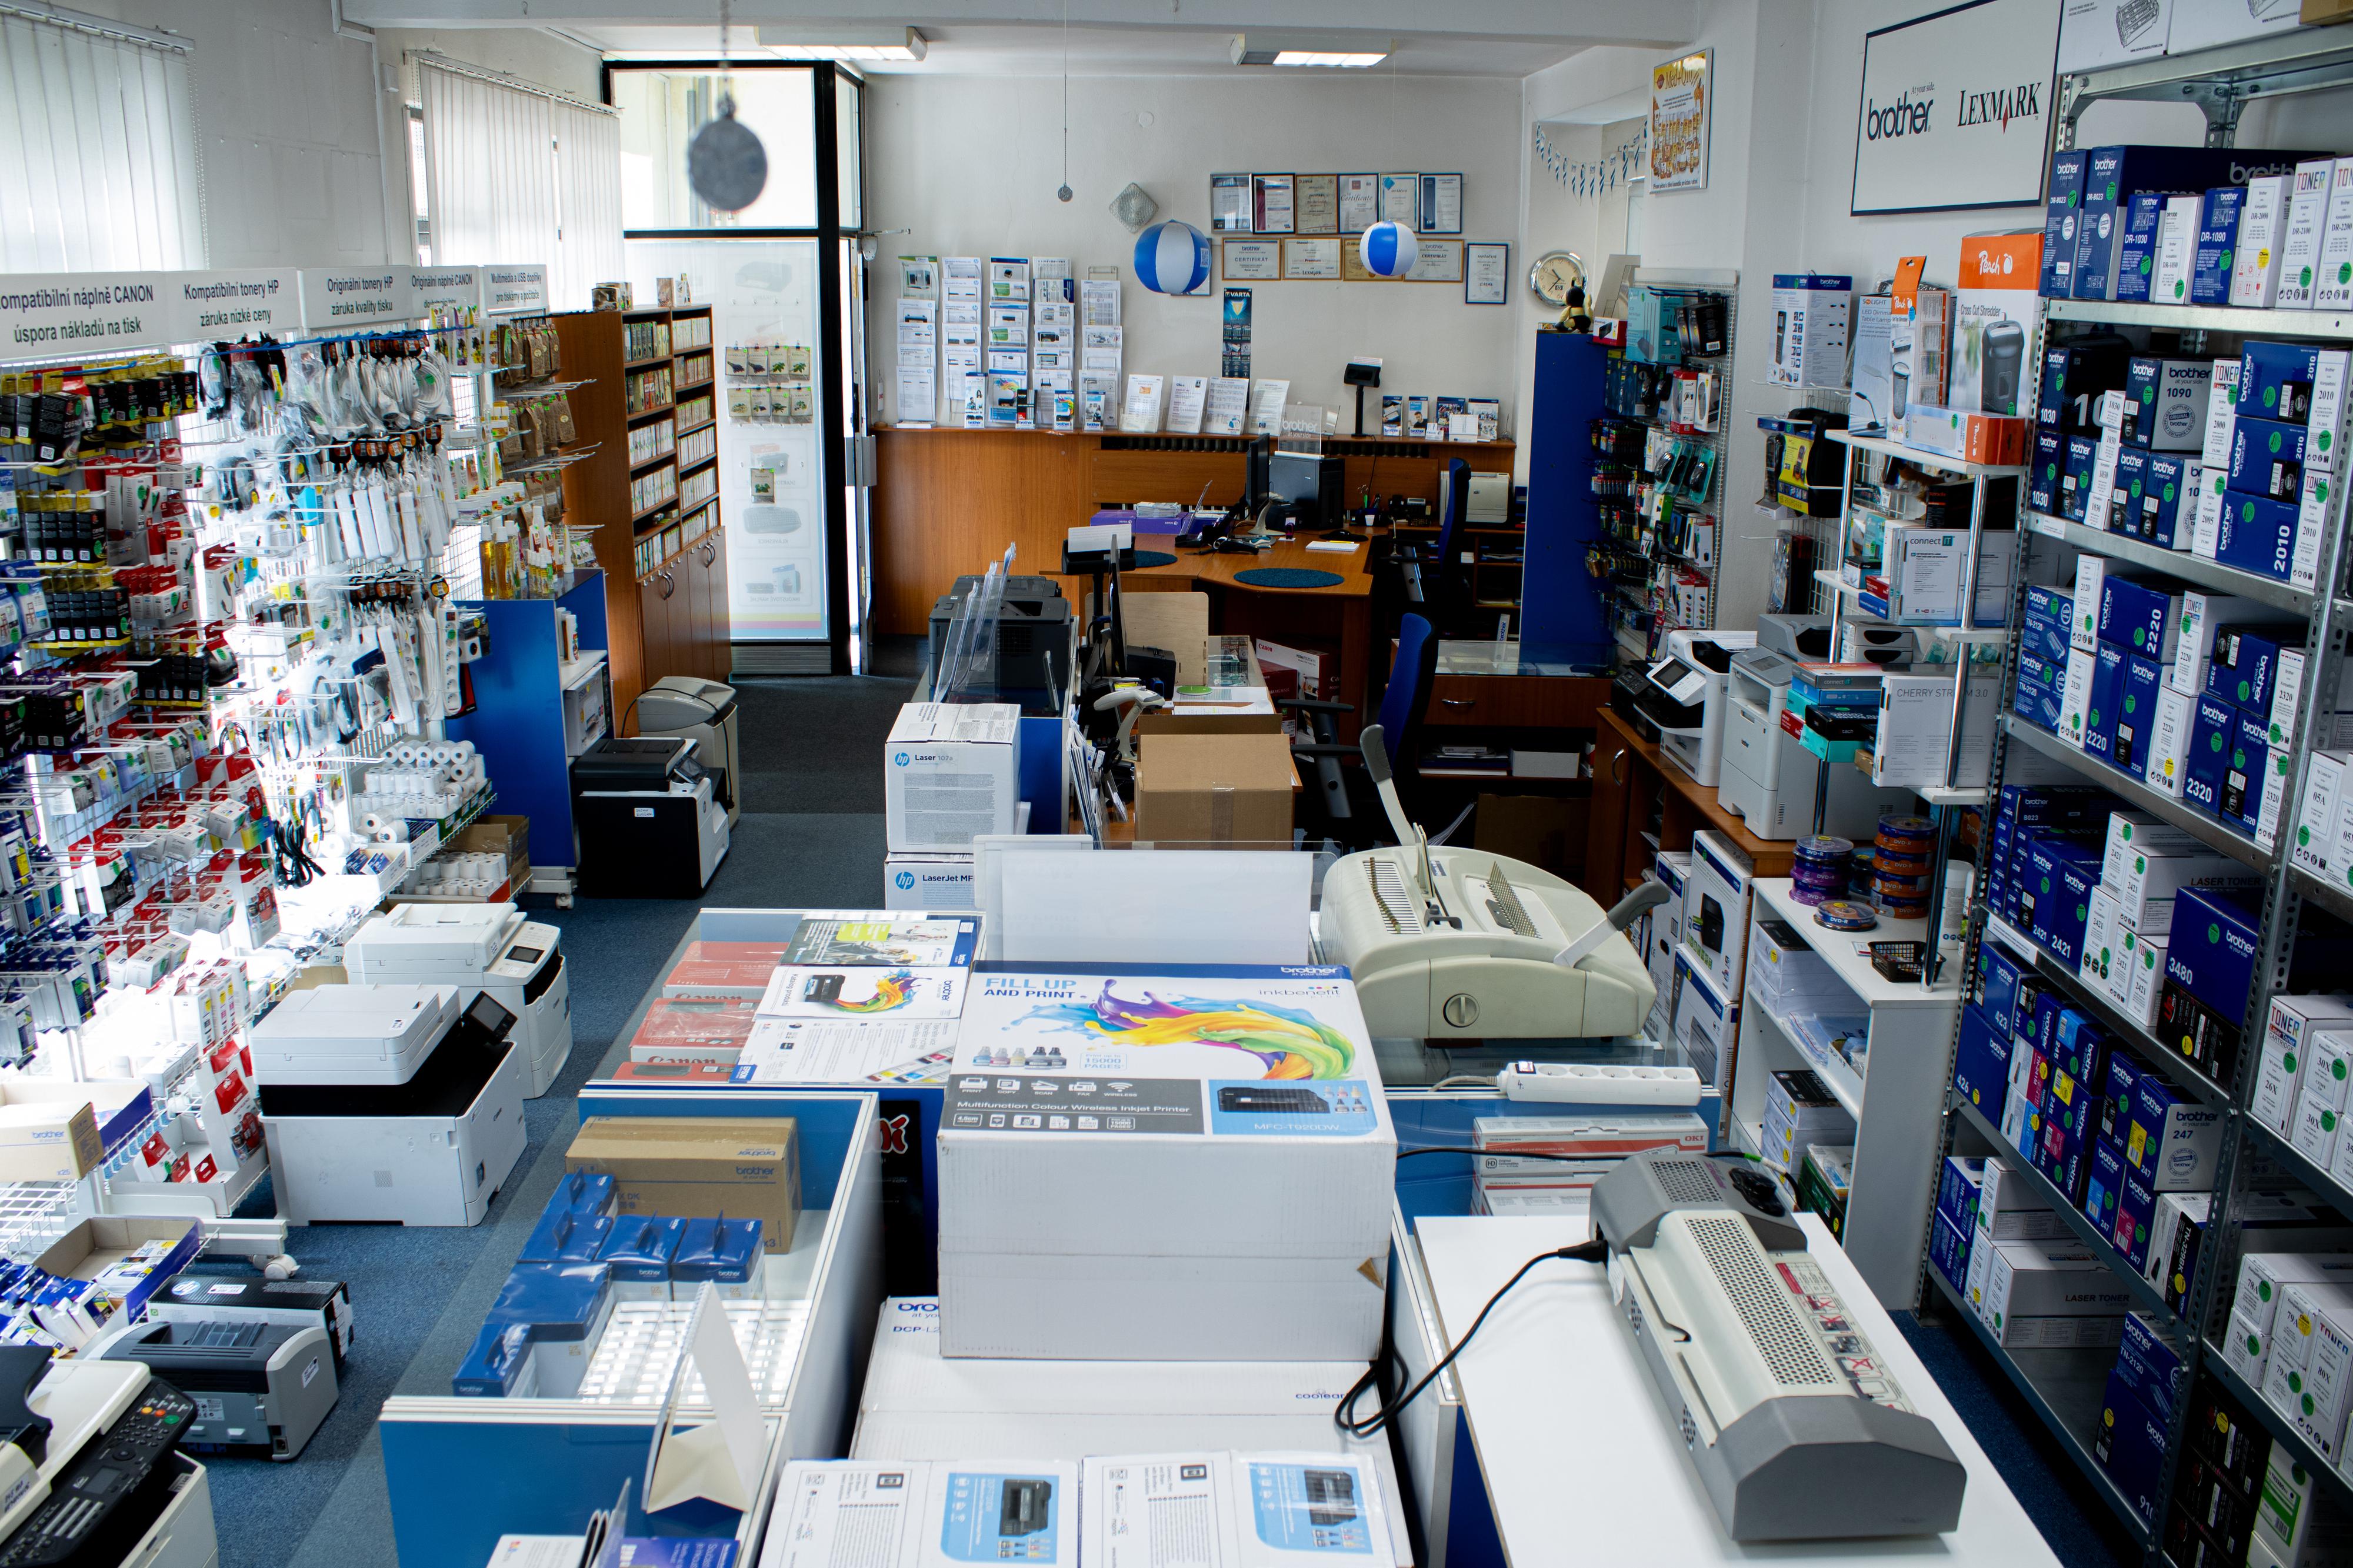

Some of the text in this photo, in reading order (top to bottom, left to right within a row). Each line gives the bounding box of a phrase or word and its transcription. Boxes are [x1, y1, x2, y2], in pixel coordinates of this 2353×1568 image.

[1957, 82, 2042, 128] LEXMARK
[1868, 91, 1934, 141] brother
[2057, 164, 2079, 175] brother
[1341, 195, 1373, 203] Certificate
[2124, 234, 2147, 245] DR-1030
[2201, 232, 2225, 243] DR-1090
[328, 276, 393, 295] Originální tonery HP
[412, 273, 472, 290] Originální náplně CANON
[491, 273, 513, 283] Multimédia
[518, 272, 526, 282] USB
[74, 286, 111, 311] náplně
[114, 285, 154, 303] CANON
[184, 280, 279, 302] Kompatibilní tonery HP
[332, 299, 392, 316] záruka kvality tisku
[1961, 304, 1971, 315] Cross
[1980, 305, 2001, 317] Shredder
[201, 309, 271, 327] záruka nízké ceny
[14, 316, 142, 346] úspora nákladů na tisk
[2168, 368, 2211, 378] brother
[2307, 356, 2316, 380] 2010
[2239, 353, 2252, 402] brother
[2167, 388, 2191, 398] 1090
[2041, 408, 2055, 424] 1030
[1282, 418, 1318, 433] brother
[2295, 436, 2304, 459] 2010
[2121, 454, 2143, 468] brother
[2032, 491, 2048, 508] 1030
[2274, 525, 2290, 573] 2010
[2147, 609, 2161, 654] 2220
[1258, 643, 1272, 652] Canon
[1897, 689, 1932, 697] CHERRY
[1975, 689, 1988, 698] 3.0
[2202, 704, 2228, 724] brother
[2086, 730, 2107, 752] 2220
[2187, 778, 2212, 803] 2320
[2243, 814, 2255, 826] 2320
[2191, 877, 2261, 886] LASER TONER
[2052, 935, 2071, 959] 2421
[2169, 957, 2192, 985] 3480
[942, 980, 954, 1001] brother
[985, 978, 1076, 989] FILL UP
[1995, 1009, 2007, 1030] 423
[2272, 1005, 2299, 1037] TONER
[739, 1064, 754, 1080] EPSON
[1957, 1073, 1969, 1093] 426
[2265, 1079, 2278, 1096] 26X
[2176, 1111, 2218, 1122] brother
[32, 1130, 65, 1139] brother
[2172, 1130, 2193, 1140] 247
[736, 1166, 774, 1176] brother
[1957, 1183, 1965, 1217] DR-1090
[1947, 1234, 1957, 1269] DR-1030
[2177, 1226, 2191, 1274] TN-329BK
[2124, 1319, 2153, 1353] brother
[2119, 1345, 2144, 1376] TN-2120
[2318, 1366, 2331, 1384] 80X
